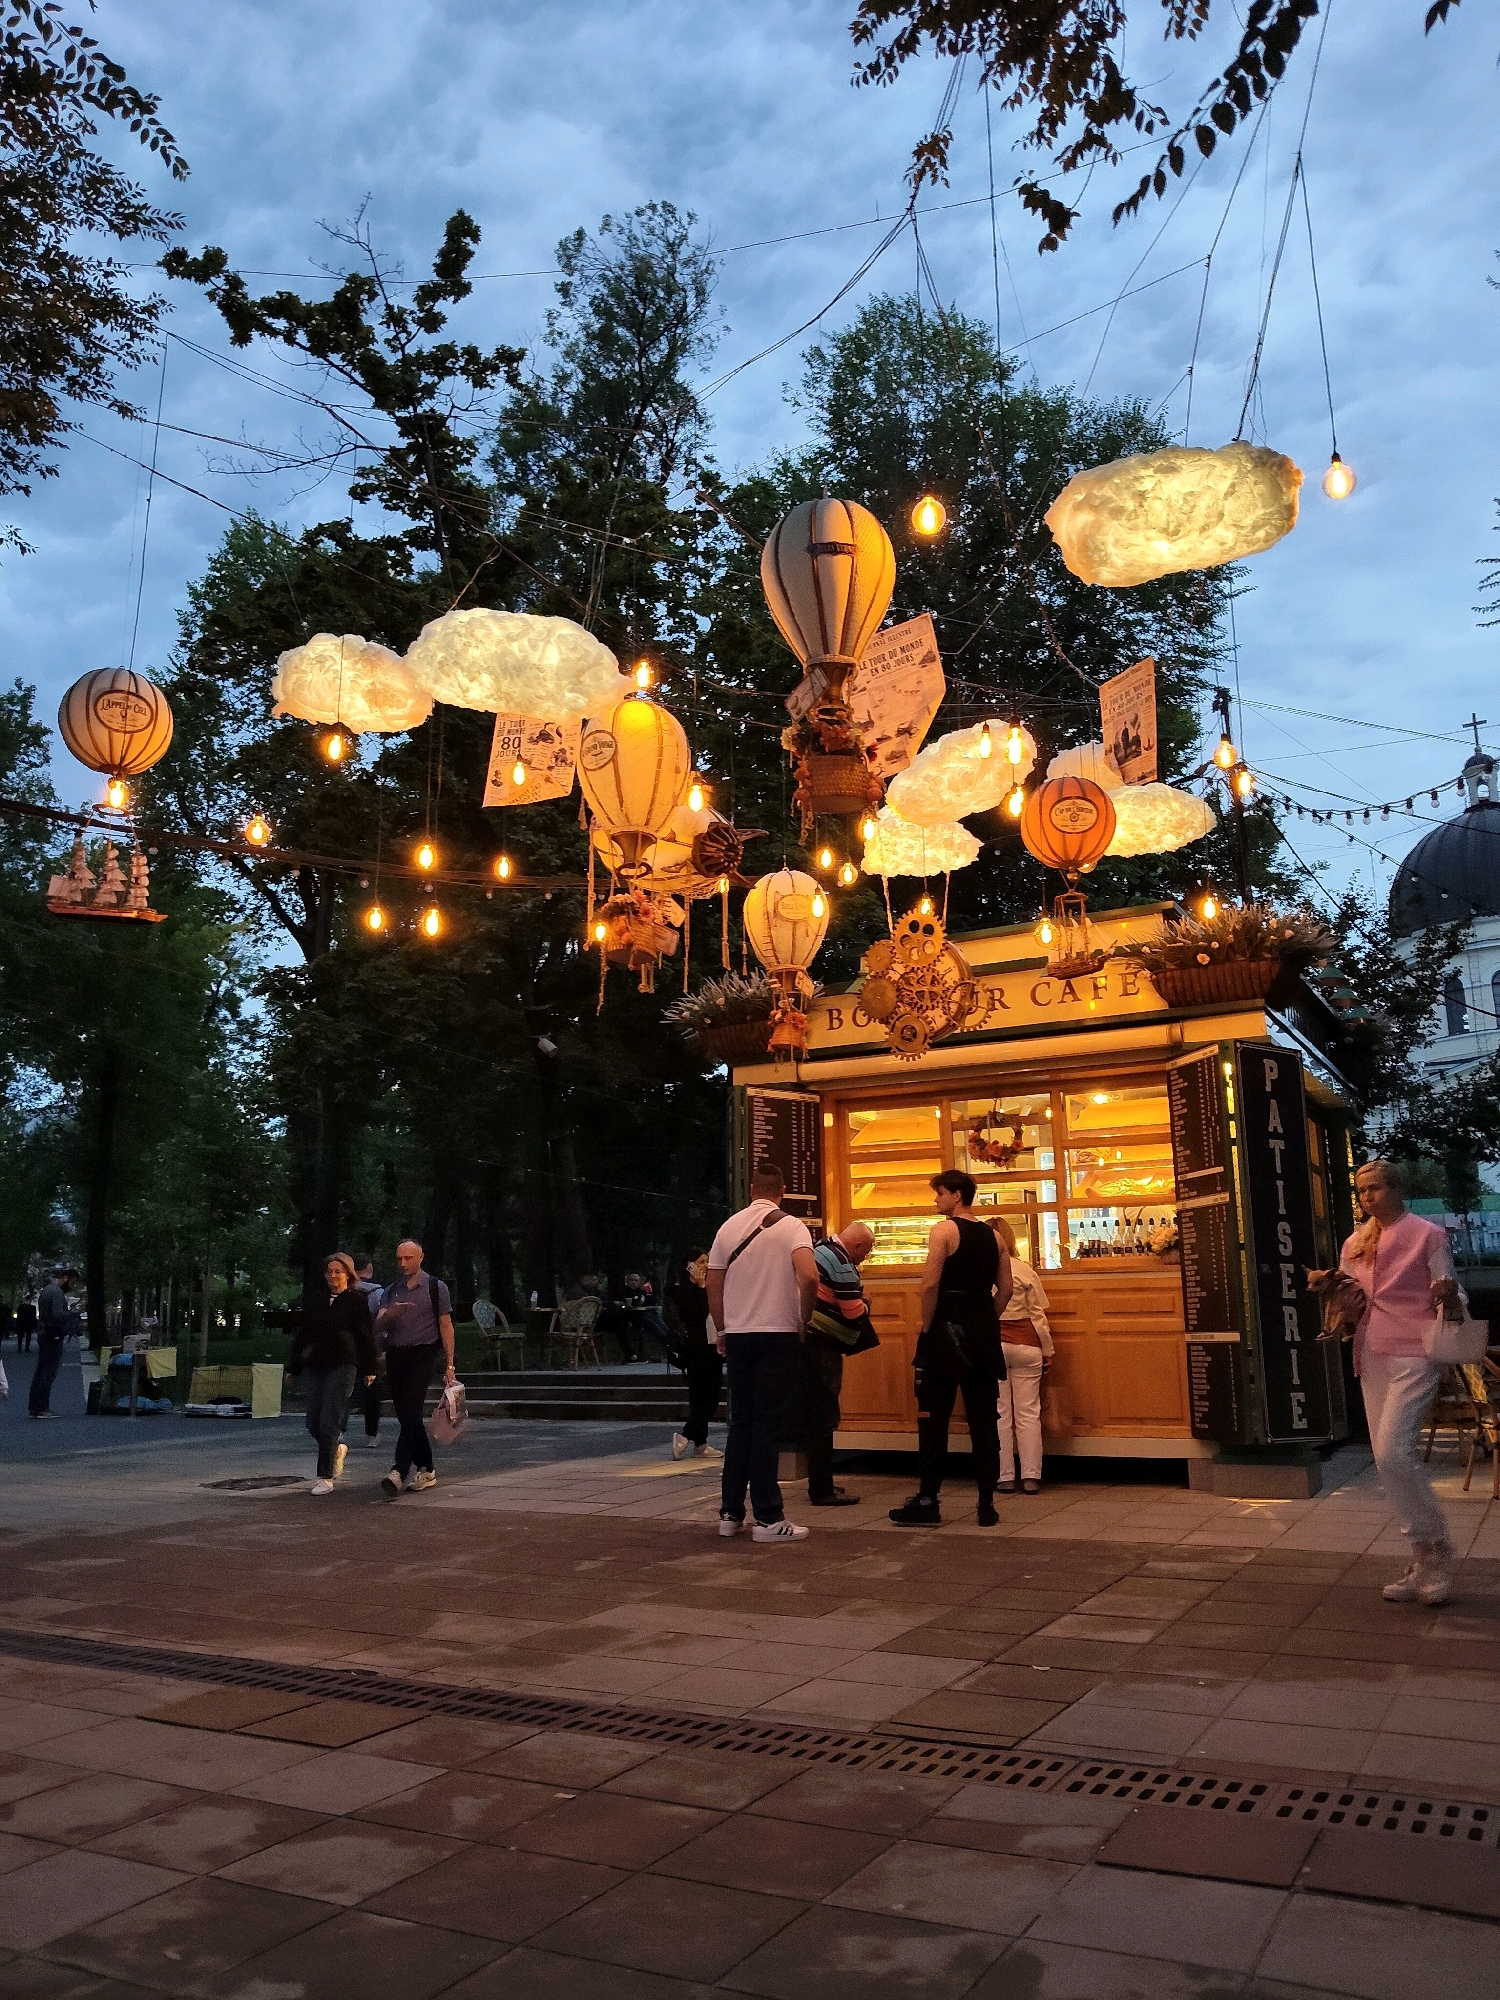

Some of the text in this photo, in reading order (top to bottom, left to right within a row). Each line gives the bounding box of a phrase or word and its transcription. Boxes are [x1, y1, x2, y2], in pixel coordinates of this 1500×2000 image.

[860, 638, 925, 671] LE TOUR DU MONDE
[870, 653, 915, 677] EN 80 JOURS
[501, 736, 522, 750] 80
[1263, 1058, 1308, 1430] PATISERIE
